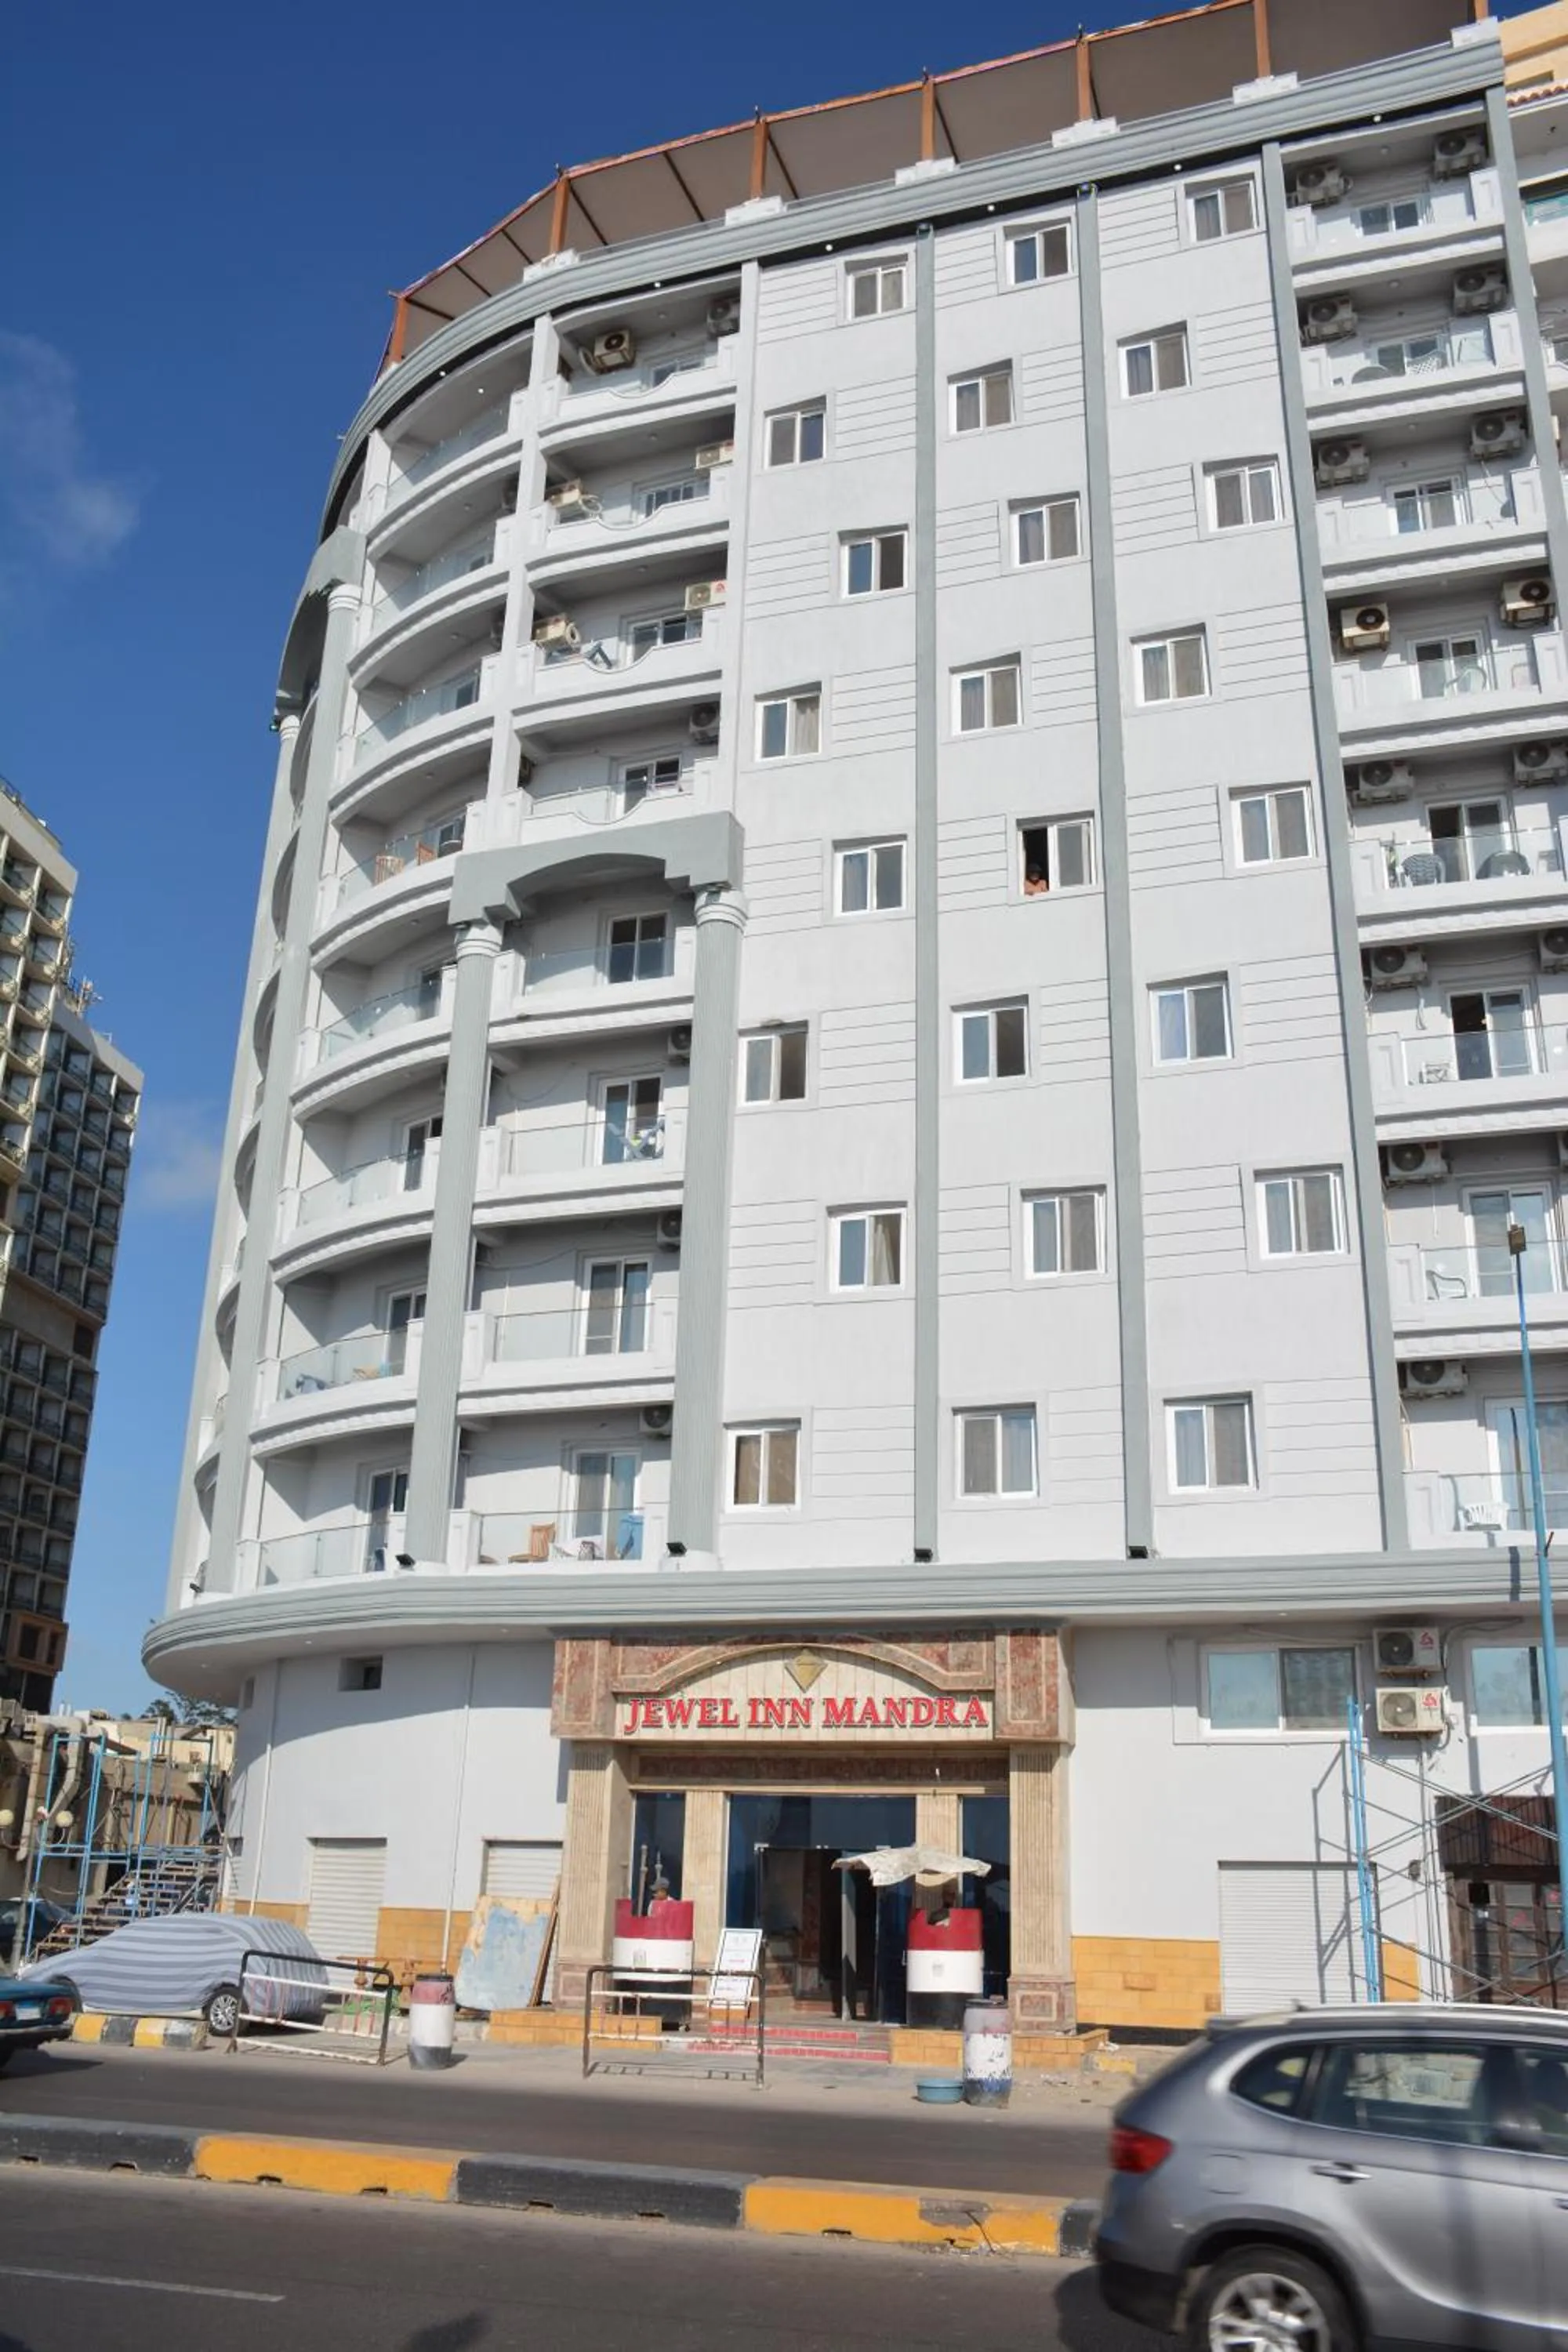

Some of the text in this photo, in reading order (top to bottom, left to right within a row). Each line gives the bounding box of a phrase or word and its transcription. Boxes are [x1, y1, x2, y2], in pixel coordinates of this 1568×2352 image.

[624, 1696, 989, 1734] JEWEL INN MANDRA
